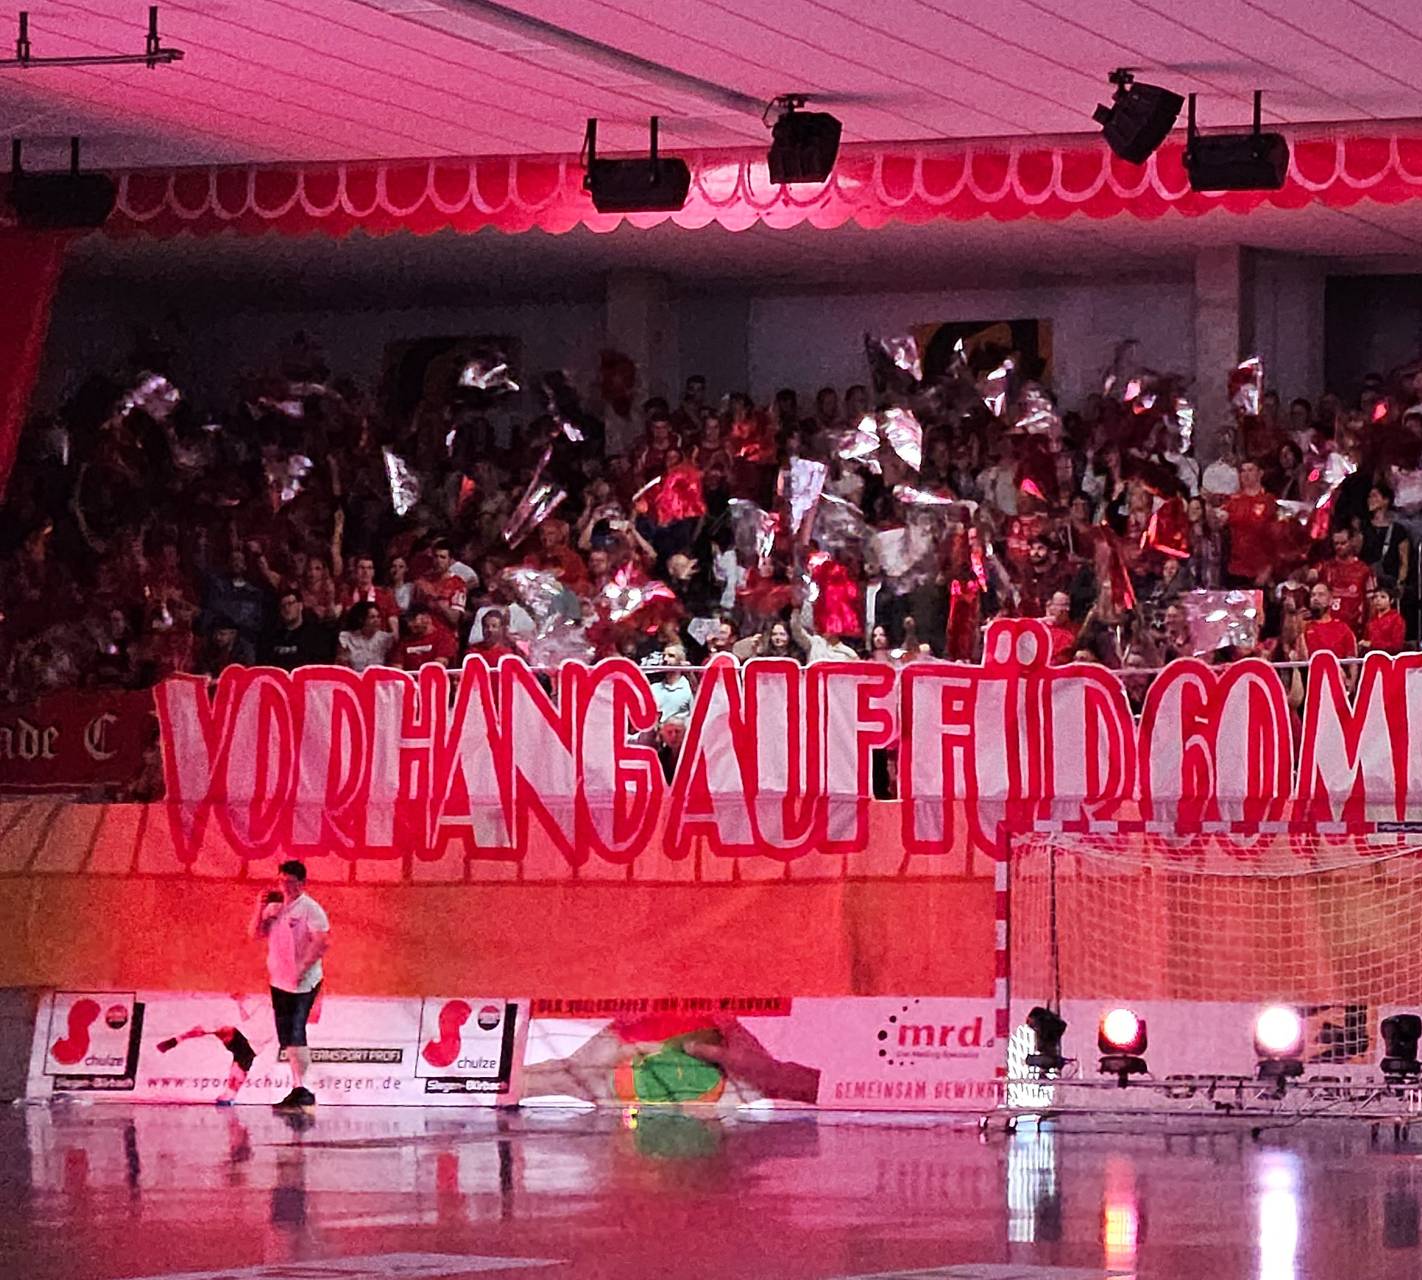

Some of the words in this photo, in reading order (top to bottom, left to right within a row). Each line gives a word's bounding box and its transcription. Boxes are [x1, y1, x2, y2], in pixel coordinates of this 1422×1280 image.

[155, 653, 669, 862] VORHANG
[668, 652, 900, 860] AUF
[896, 617, 1139, 860] FÜR
[1139, 653, 1295, 860] 60
[834, 1081, 927, 1099] GEMEINSAM
